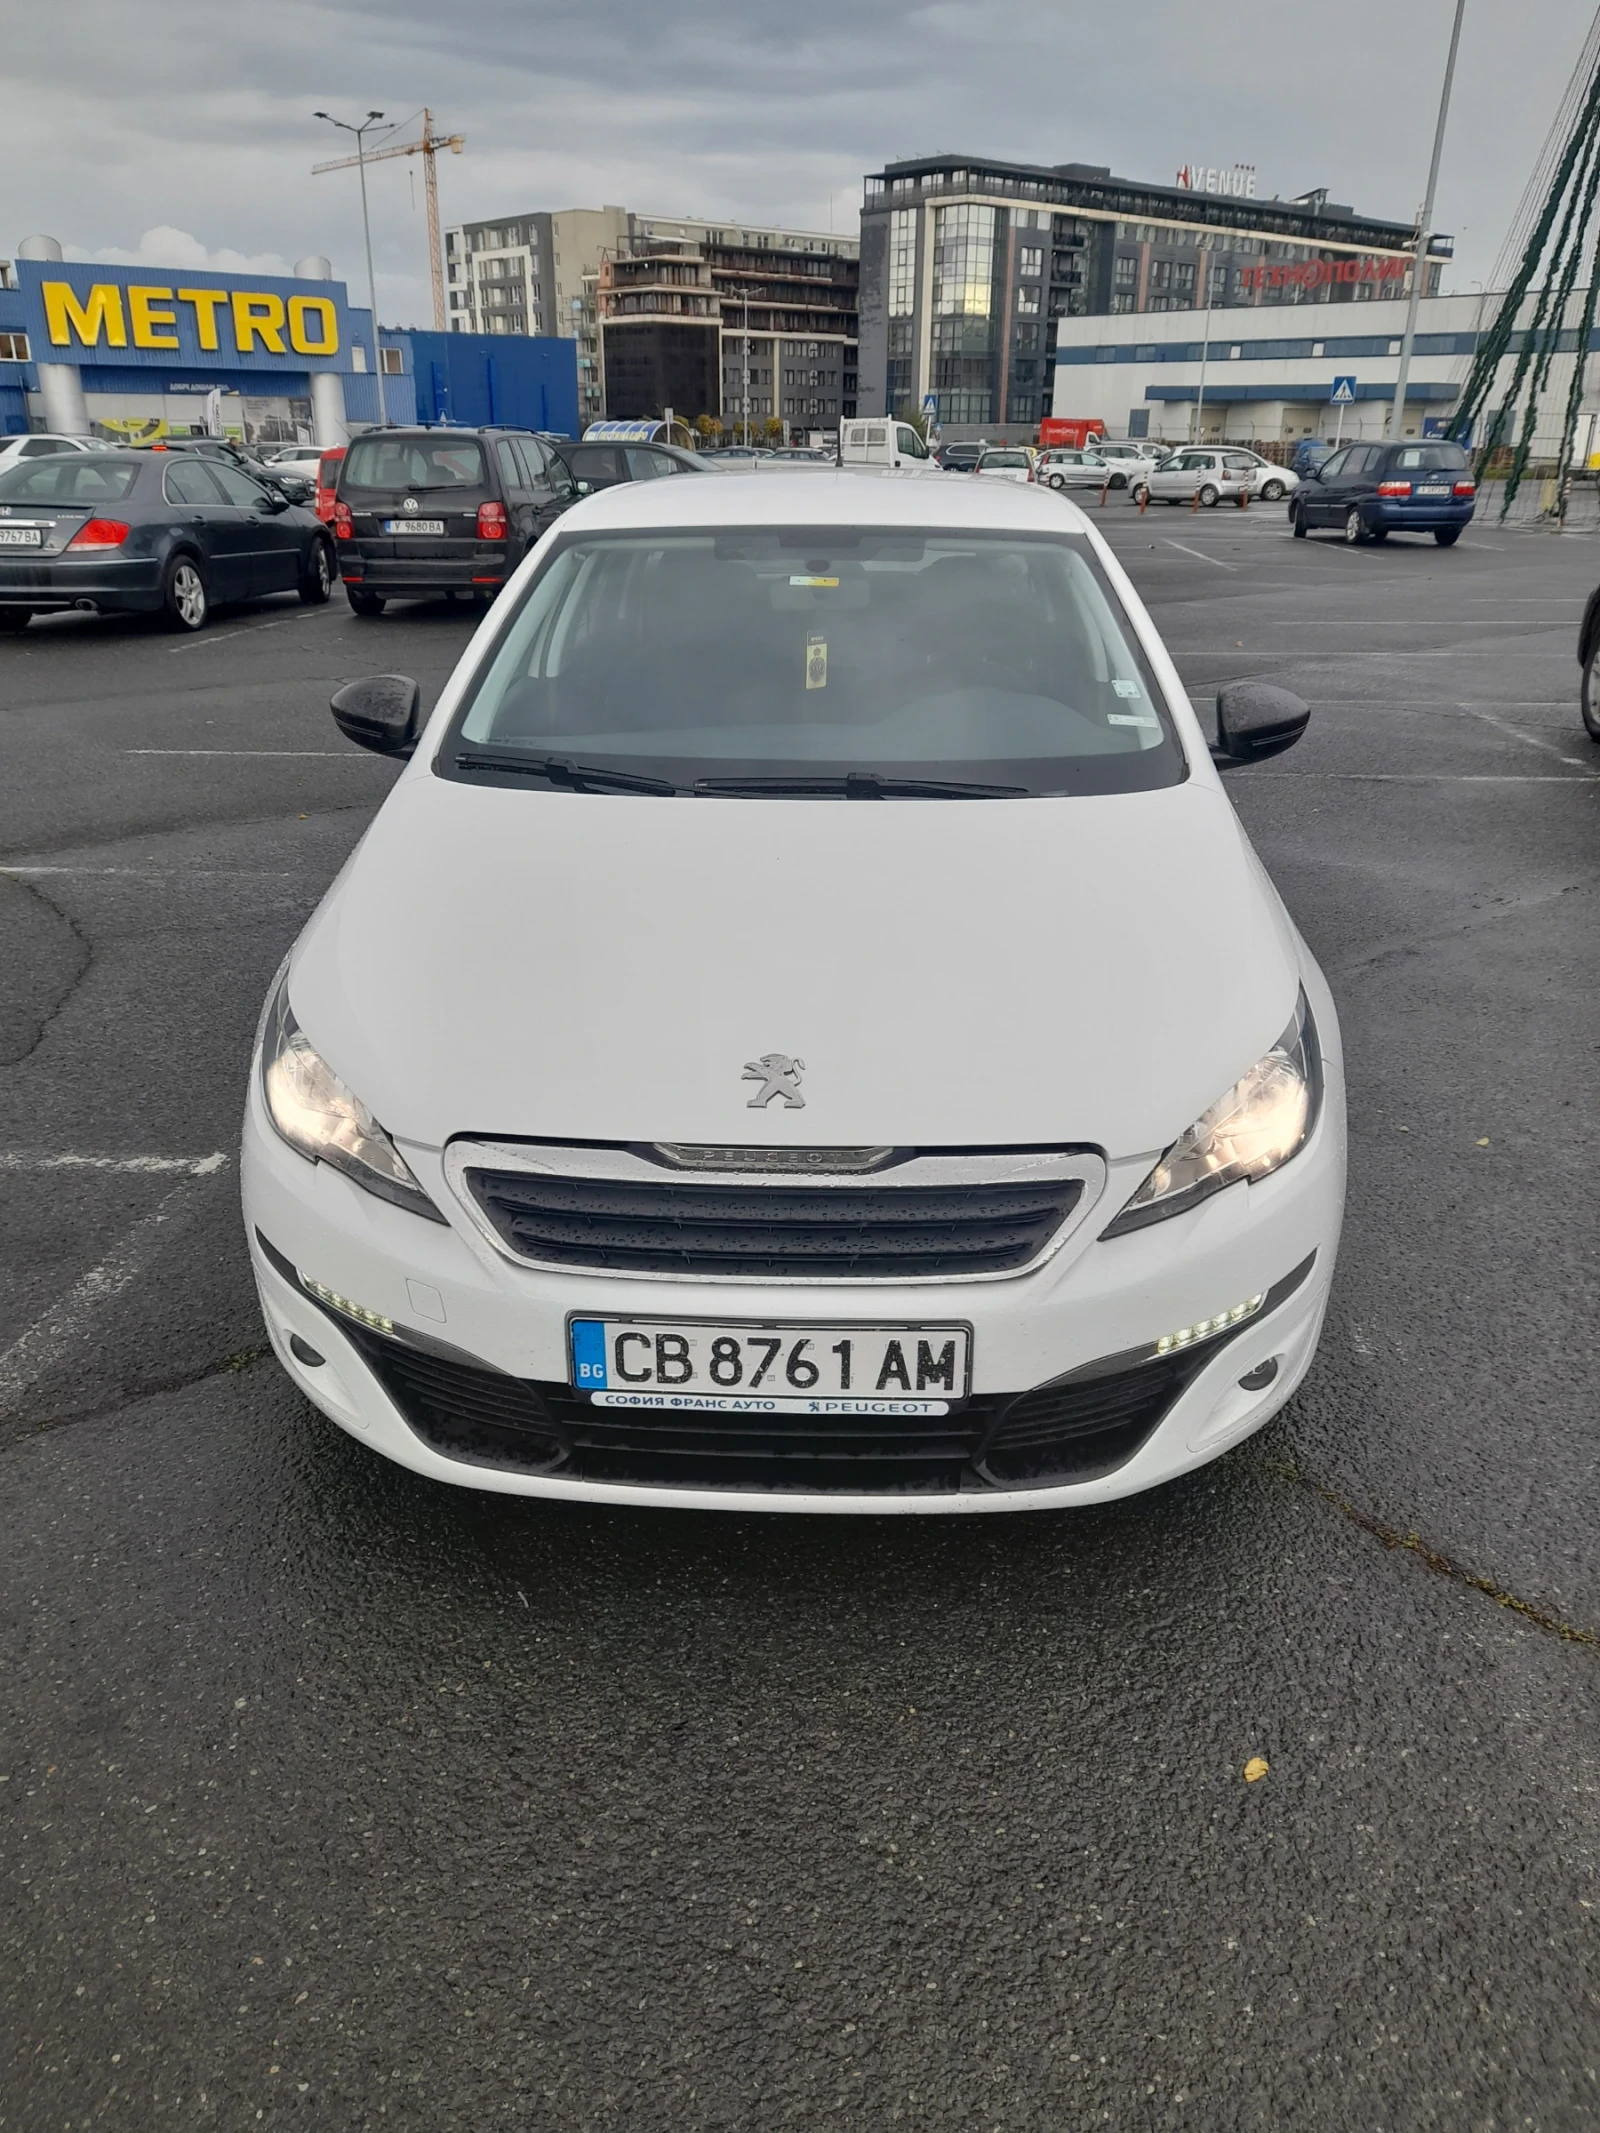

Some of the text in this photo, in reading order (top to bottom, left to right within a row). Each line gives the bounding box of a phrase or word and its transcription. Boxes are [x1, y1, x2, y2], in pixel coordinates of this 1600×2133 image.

[1176, 164, 1257, 198] AVENUE
[41, 281, 339, 355] METRO
[405, 522, 428, 532] 9680
[429, 522, 442, 532] BA
[25, 532, 38, 543] BA
[703, 1150, 842, 1163] PEUGEOT
[579, 1332, 955, 1391] BG CB 8761 AM
[605, 1395, 933, 1414] СОФИЯ ФРАНС АУТО PEUGEOT
